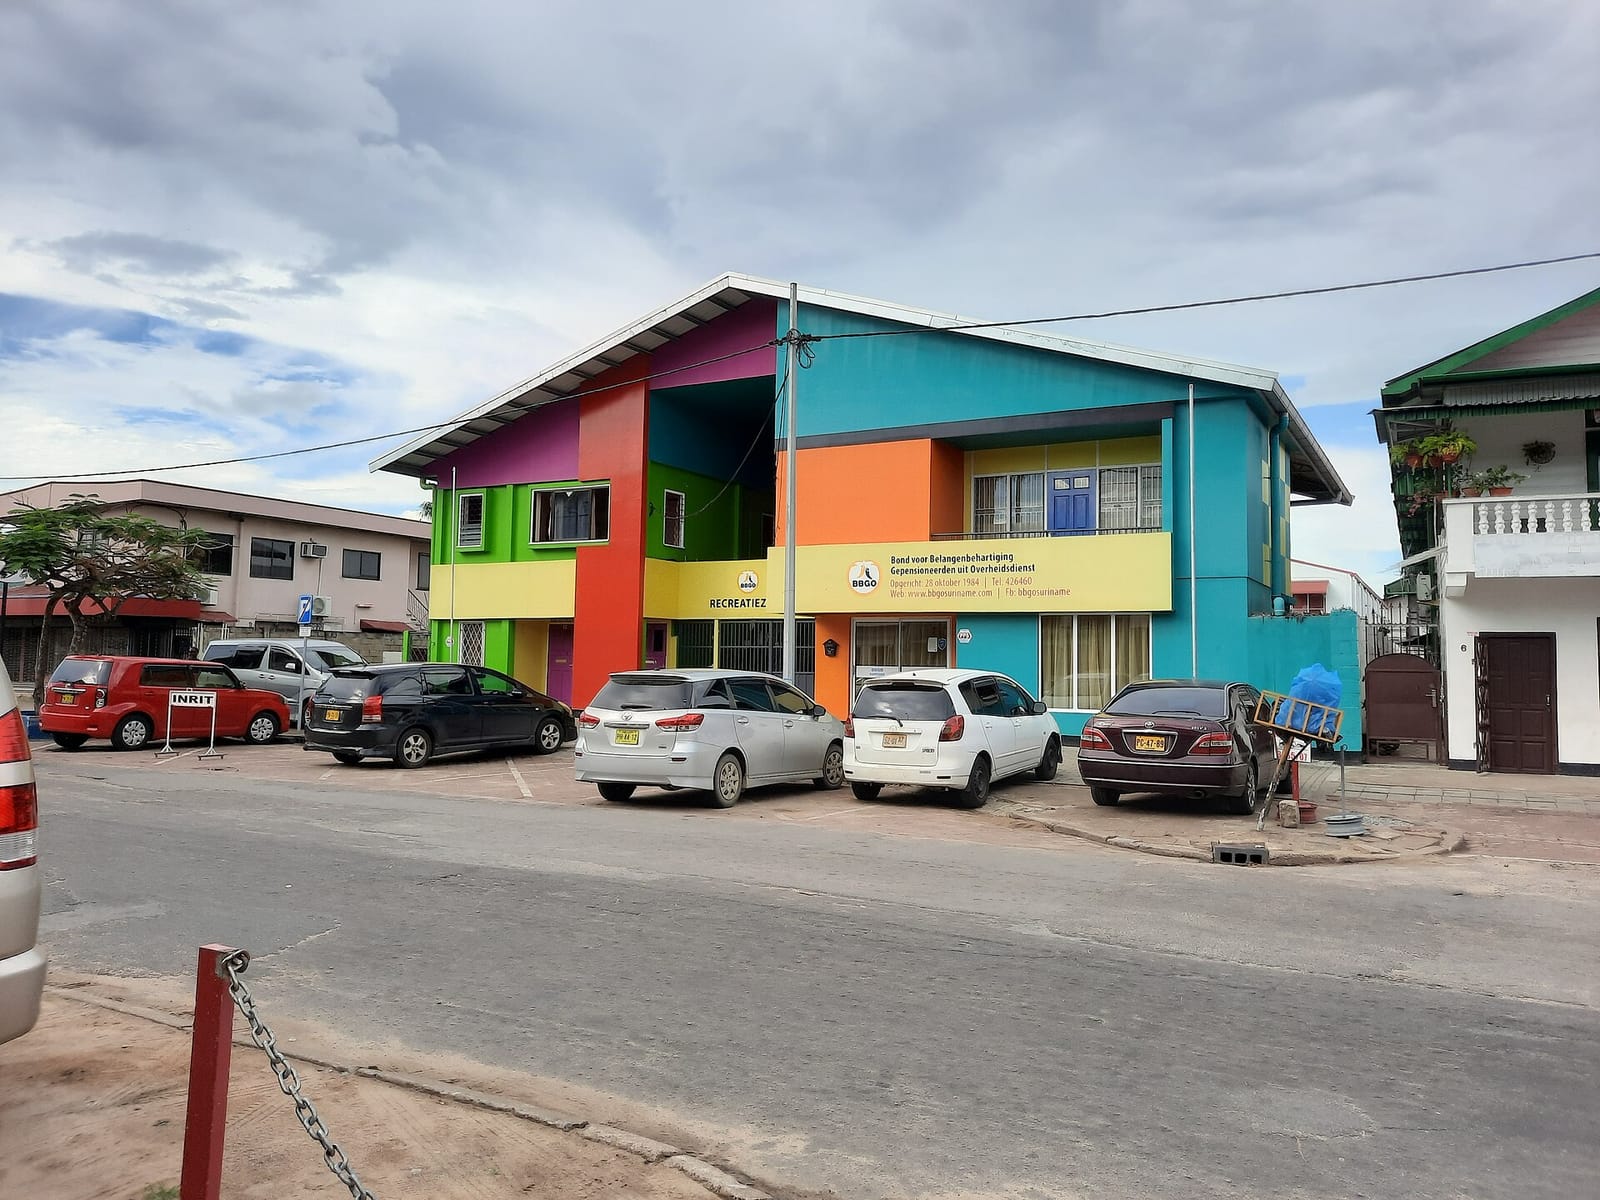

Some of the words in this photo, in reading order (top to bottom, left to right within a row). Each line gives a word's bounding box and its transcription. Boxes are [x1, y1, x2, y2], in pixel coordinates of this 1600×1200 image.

[890, 555, 910, 564] Bond
[911, 556, 928, 564] voor
[929, 552, 1014, 565] Belangenbehartiging
[890, 565, 956, 576] Gepensioneerden
[957, 564, 968, 574] uit
[970, 563, 1036, 573] Overheidsdienst
[925, 579, 933, 588] 28
[934, 577, 961, 588] oktober
[962, 577, 980, 587] 1984
[1005, 576, 1033, 586] 426460
[890, 589, 905, 598] Web:
[907, 588, 993, 600] www.bbgosuriname.com
[1005, 588, 1016, 597] Fb:
[1017, 587, 1071, 599] bbgosuriname
[710, 598, 767, 608] RECREATIEZ
[1460, 644, 1467, 652] 6
[172, 694, 214, 704] INRIT
